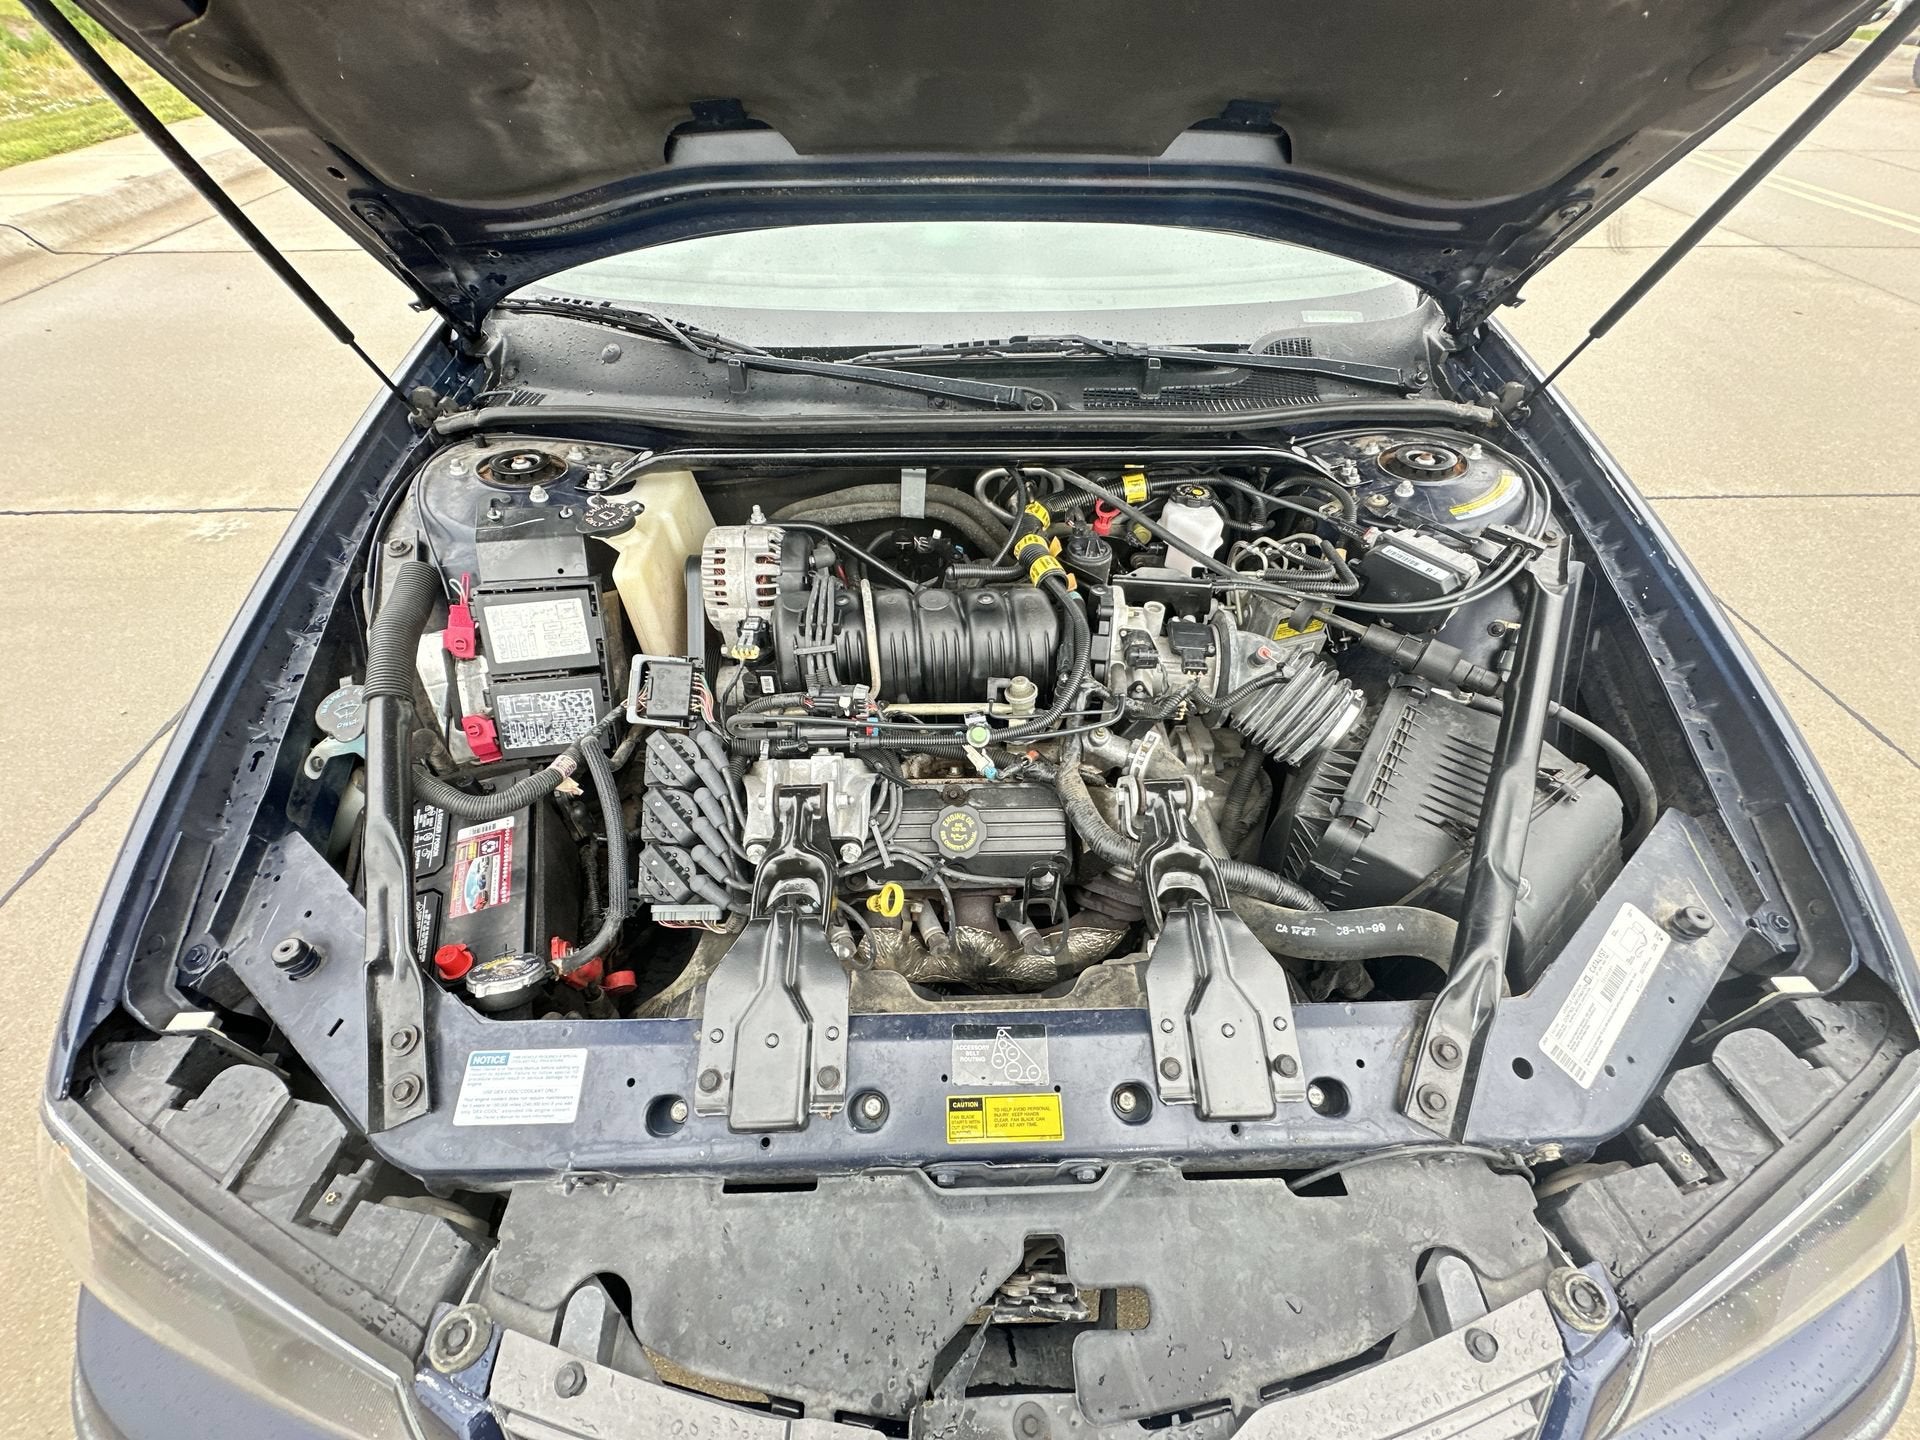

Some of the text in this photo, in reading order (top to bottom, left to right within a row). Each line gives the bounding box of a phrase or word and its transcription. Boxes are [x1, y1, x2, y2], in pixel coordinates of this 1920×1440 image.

[585, 504, 630, 527] ENGINE COOLANT ONLY
[320, 690, 348, 714] WASHER
[336, 718, 358, 729] ONLY
[942, 813, 975, 828] ENGINE OIL
[1275, 923, 1289, 934] CA
[1397, 923, 1405, 932] A
[1589, 947, 1607, 974] CATALYST
[472, 1055, 507, 1065] NOTICE
[952, 1101, 980, 1109] CAUTION
